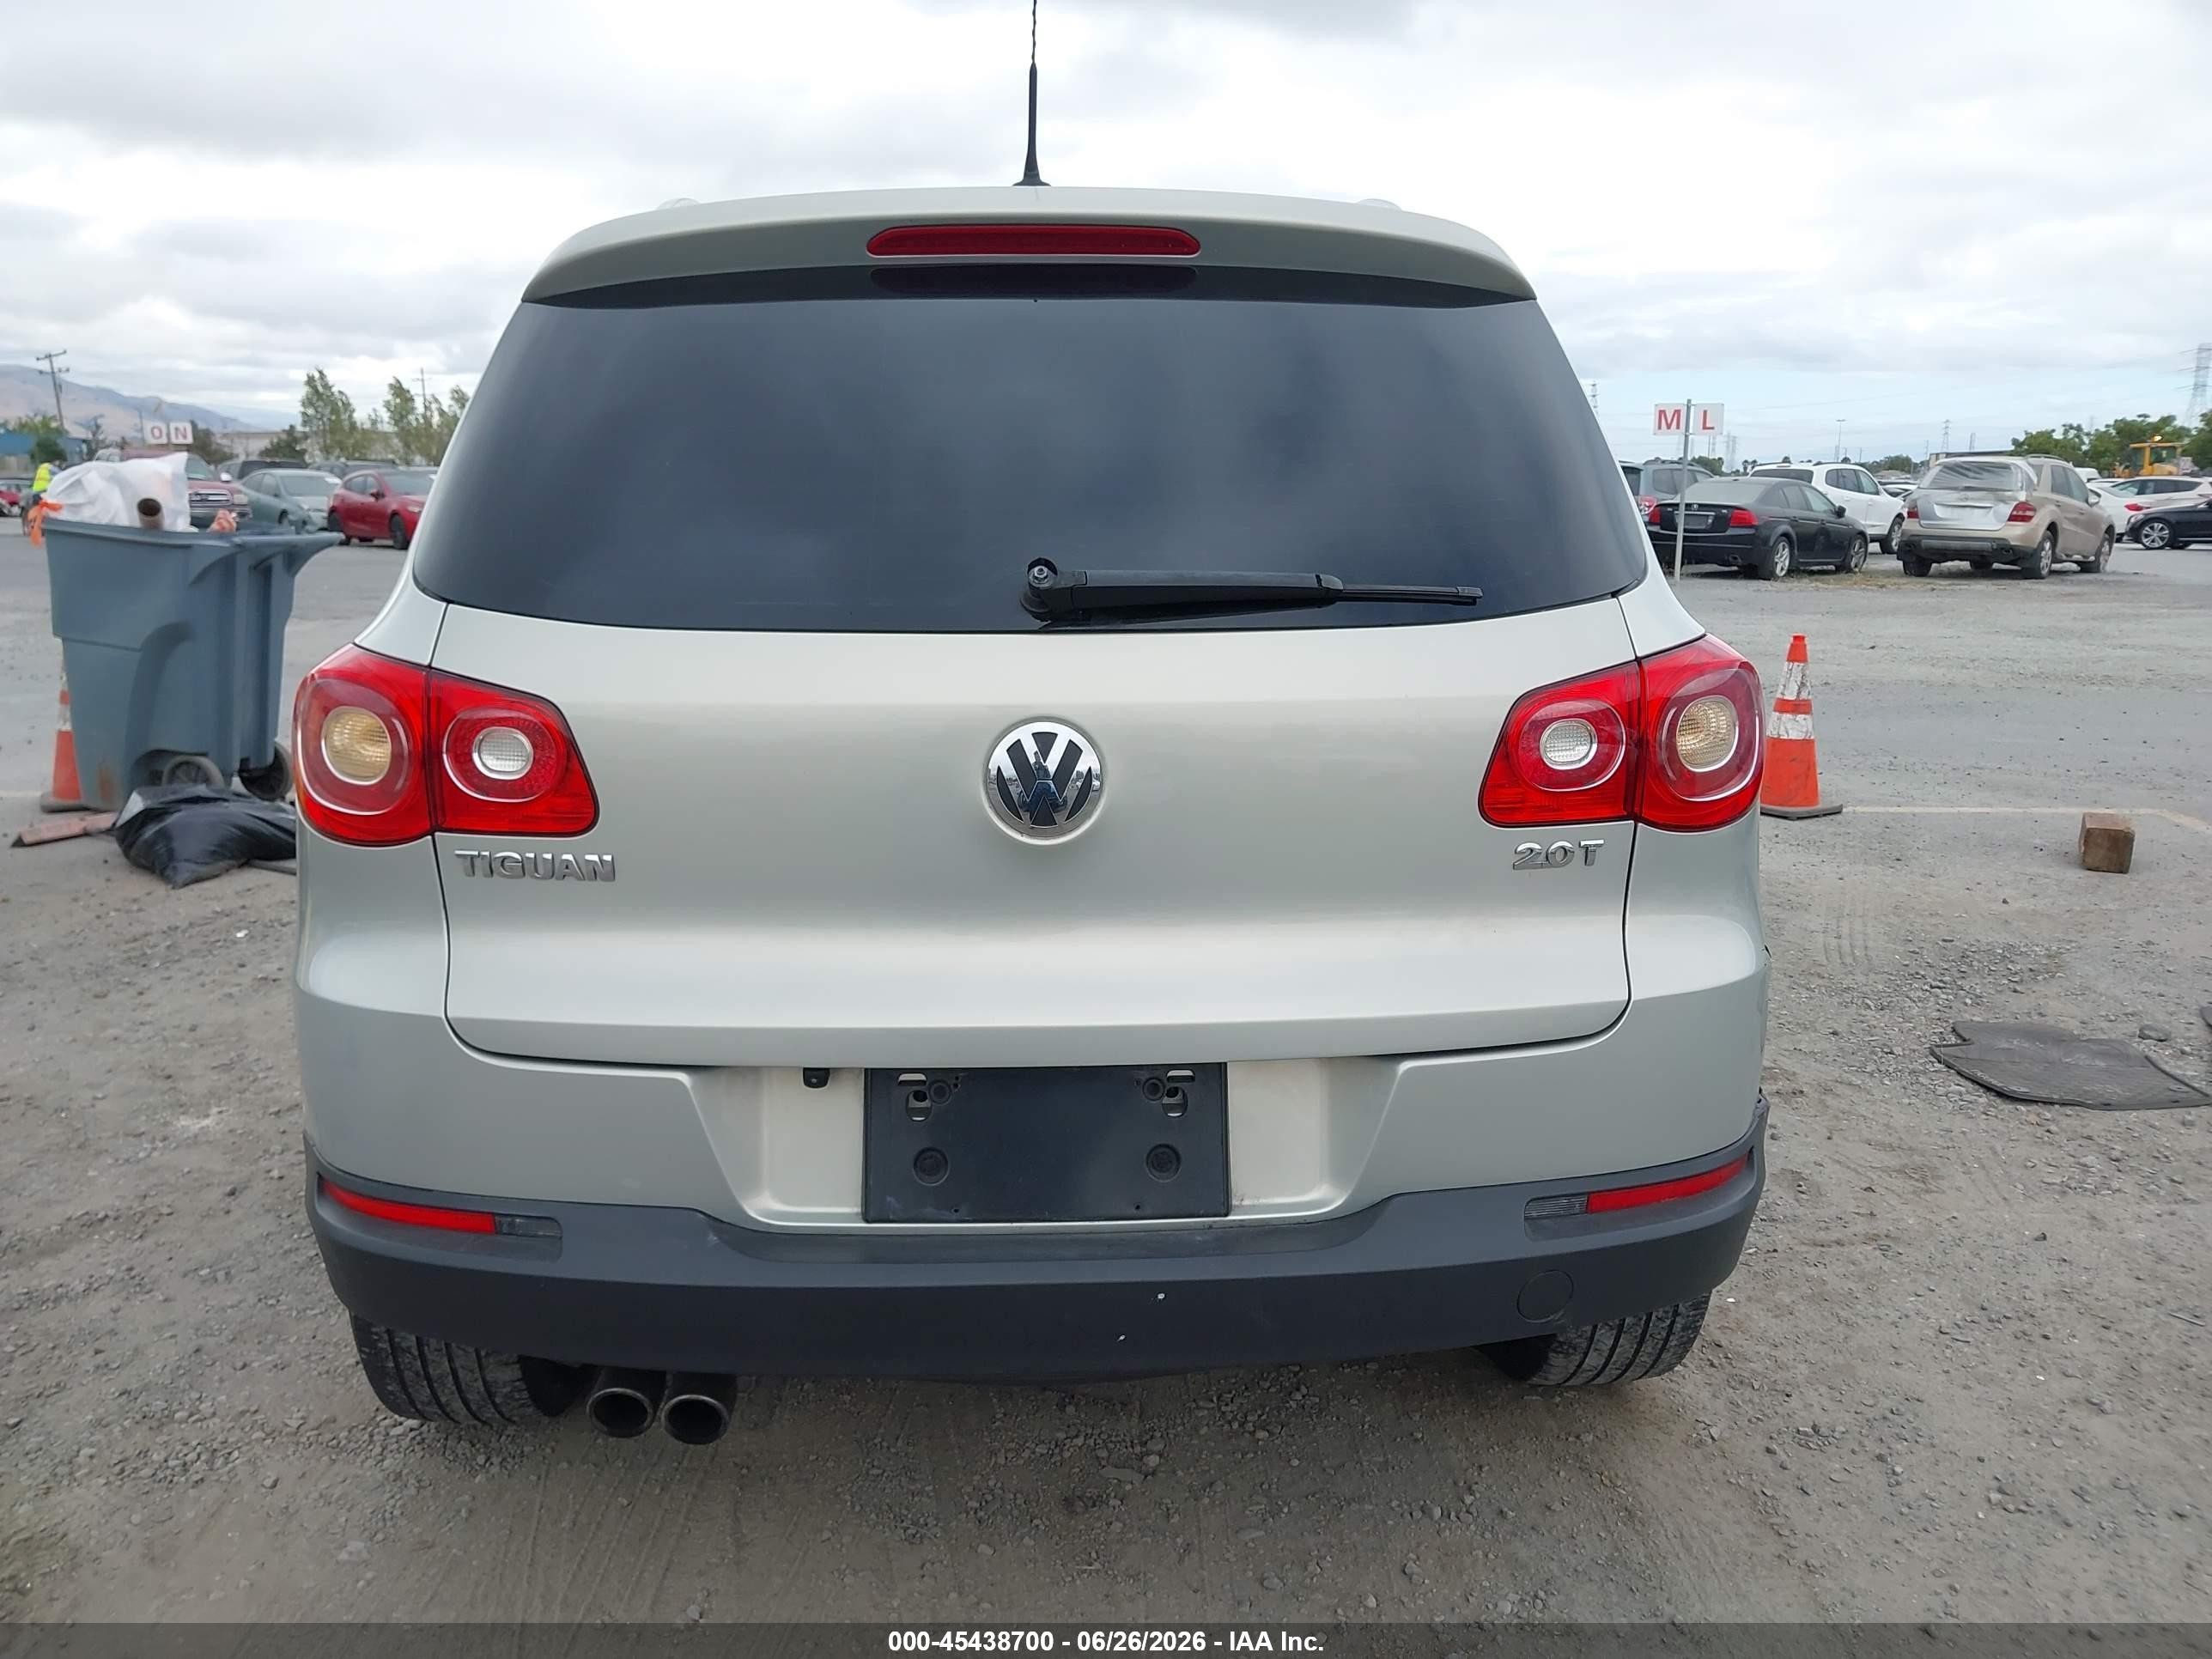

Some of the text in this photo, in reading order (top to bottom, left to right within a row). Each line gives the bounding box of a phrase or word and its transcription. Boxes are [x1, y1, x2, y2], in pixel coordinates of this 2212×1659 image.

[1657, 409, 1716, 430] M L
[150, 425, 188, 441] O N
[454, 850, 617, 882] TIGUAN
